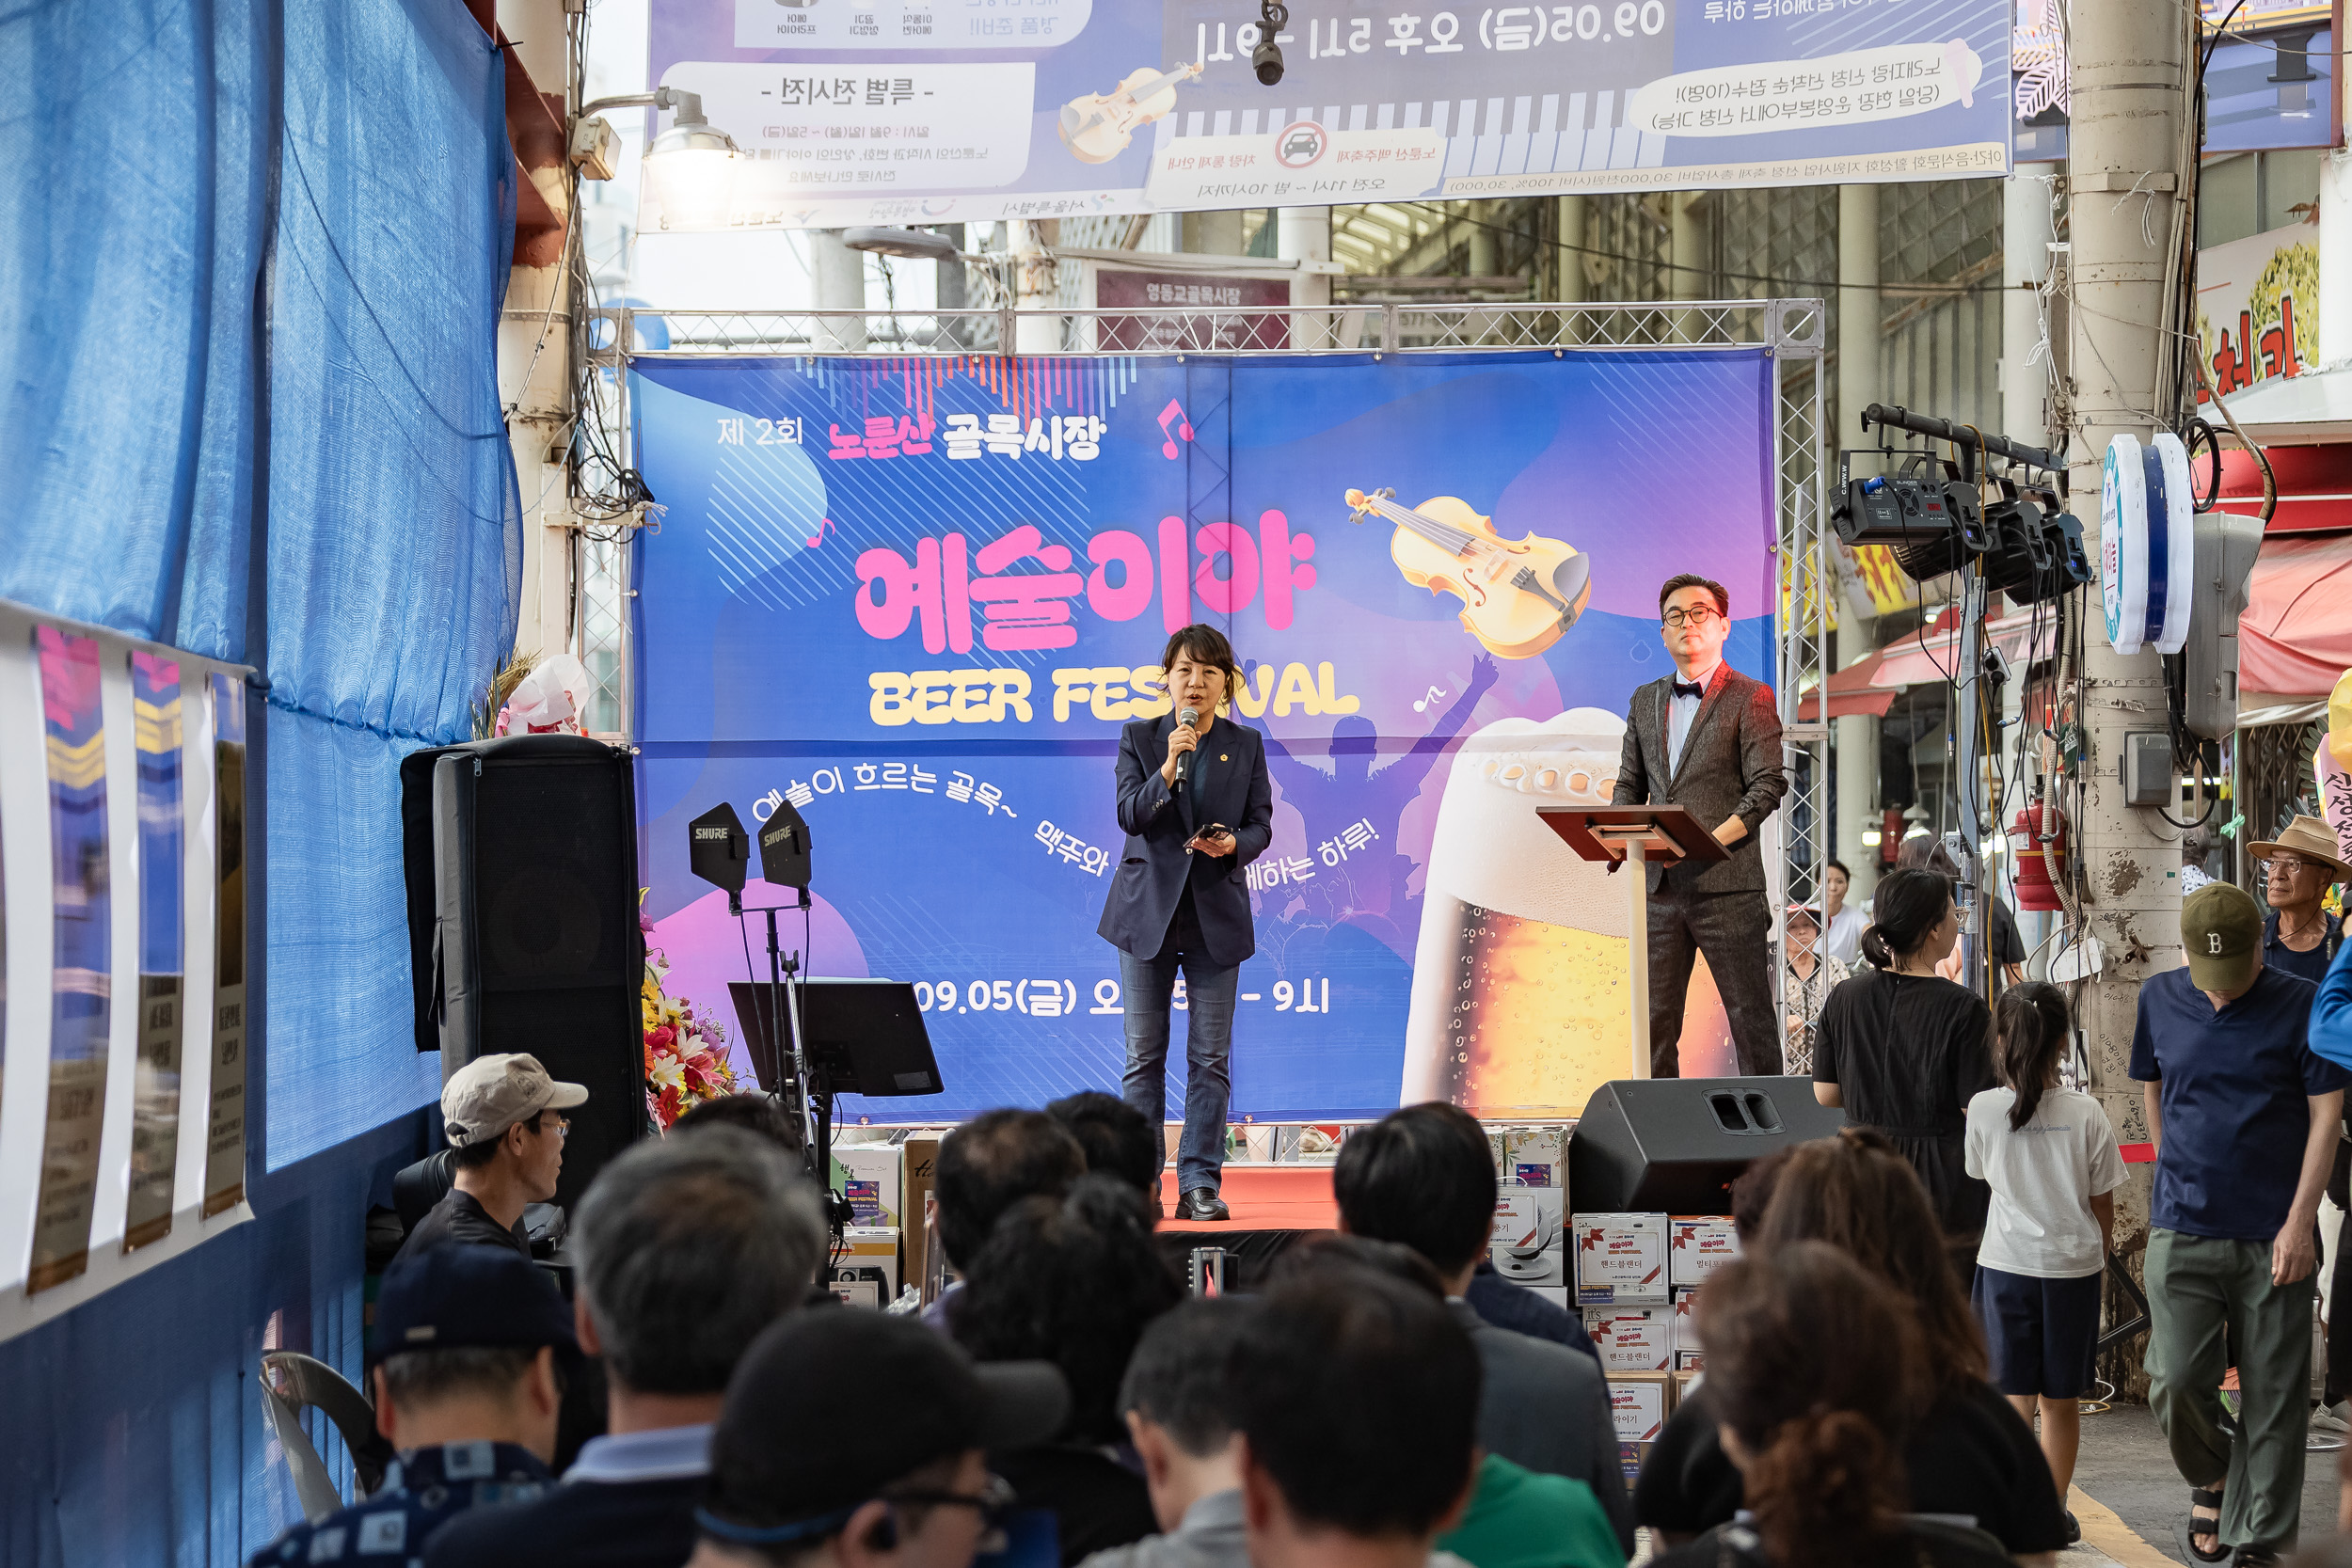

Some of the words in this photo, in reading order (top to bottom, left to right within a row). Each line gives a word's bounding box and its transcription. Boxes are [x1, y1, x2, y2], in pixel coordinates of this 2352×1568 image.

[717, 418, 745, 446] 제
[755, 416, 803, 446] 2회
[827, 412, 937, 460] 노룬산
[942, 414, 1108, 461] 골목시장
[854, 509, 1318, 656] 예술이야
[868, 668, 1033, 727] BEER
[752, 766, 846, 823] 예술이
[852, 762, 938, 794] 흐르는
[695, 827, 729, 841] SHURE
[764, 825, 792, 847] SHURE
[1033, 818, 1110, 878] 맥주와
[1316, 817, 1380, 868] 하루!
[2207, 932, 2222, 954] B
[1089, 978, 1125, 1015] 오
[1272, 977, 1329, 1015] 9시
[1600, 1259, 1643, 1270] 핸드블랜더
[1587, 1307, 1601, 1320] it's
[1609, 1352, 1651, 1362] 핸드블랜더
